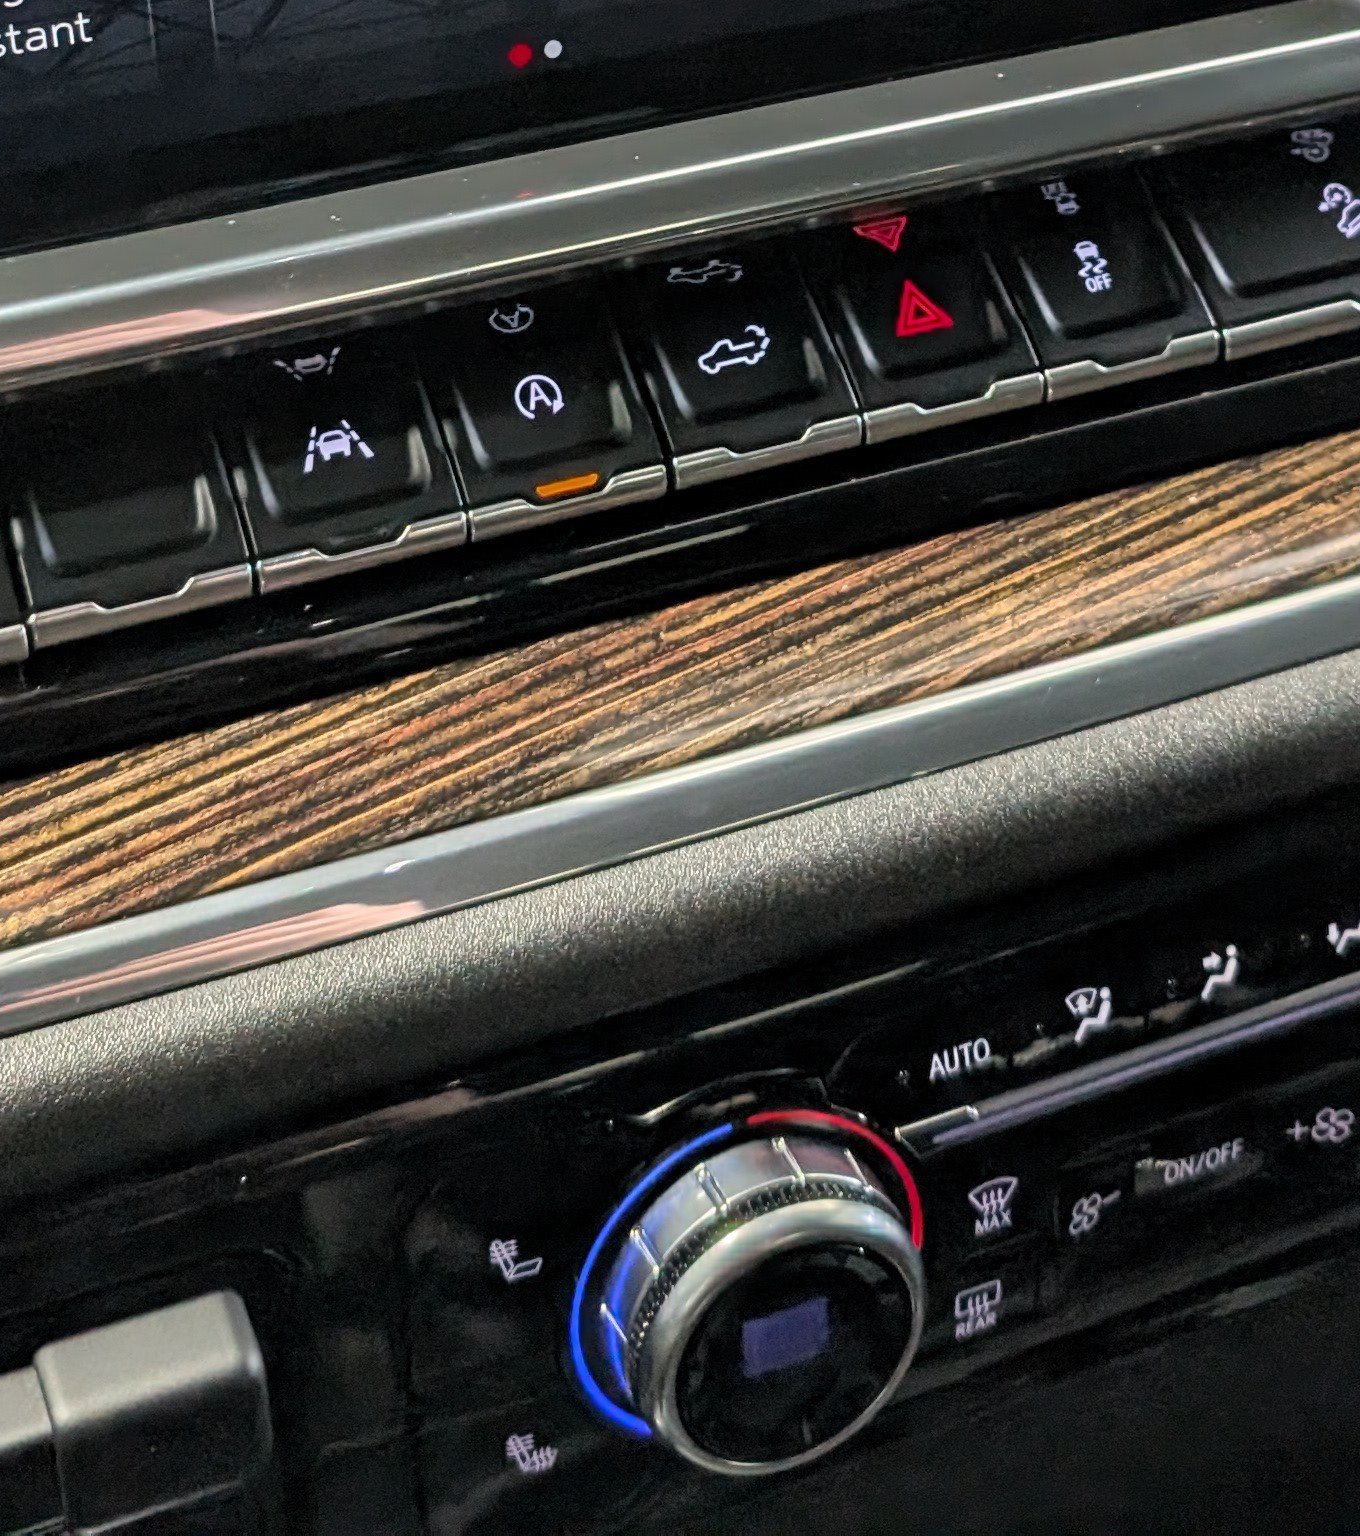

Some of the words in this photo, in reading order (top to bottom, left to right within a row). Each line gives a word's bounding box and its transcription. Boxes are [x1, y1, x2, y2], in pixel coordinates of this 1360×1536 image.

[1085, 273, 1112, 293] OFF
[929, 1037, 990, 1081] AUTO
[1164, 1137, 1244, 1183] ON/OFF
[975, 1208, 1013, 1236] MAX
[955, 1312, 996, 1341] REAR
